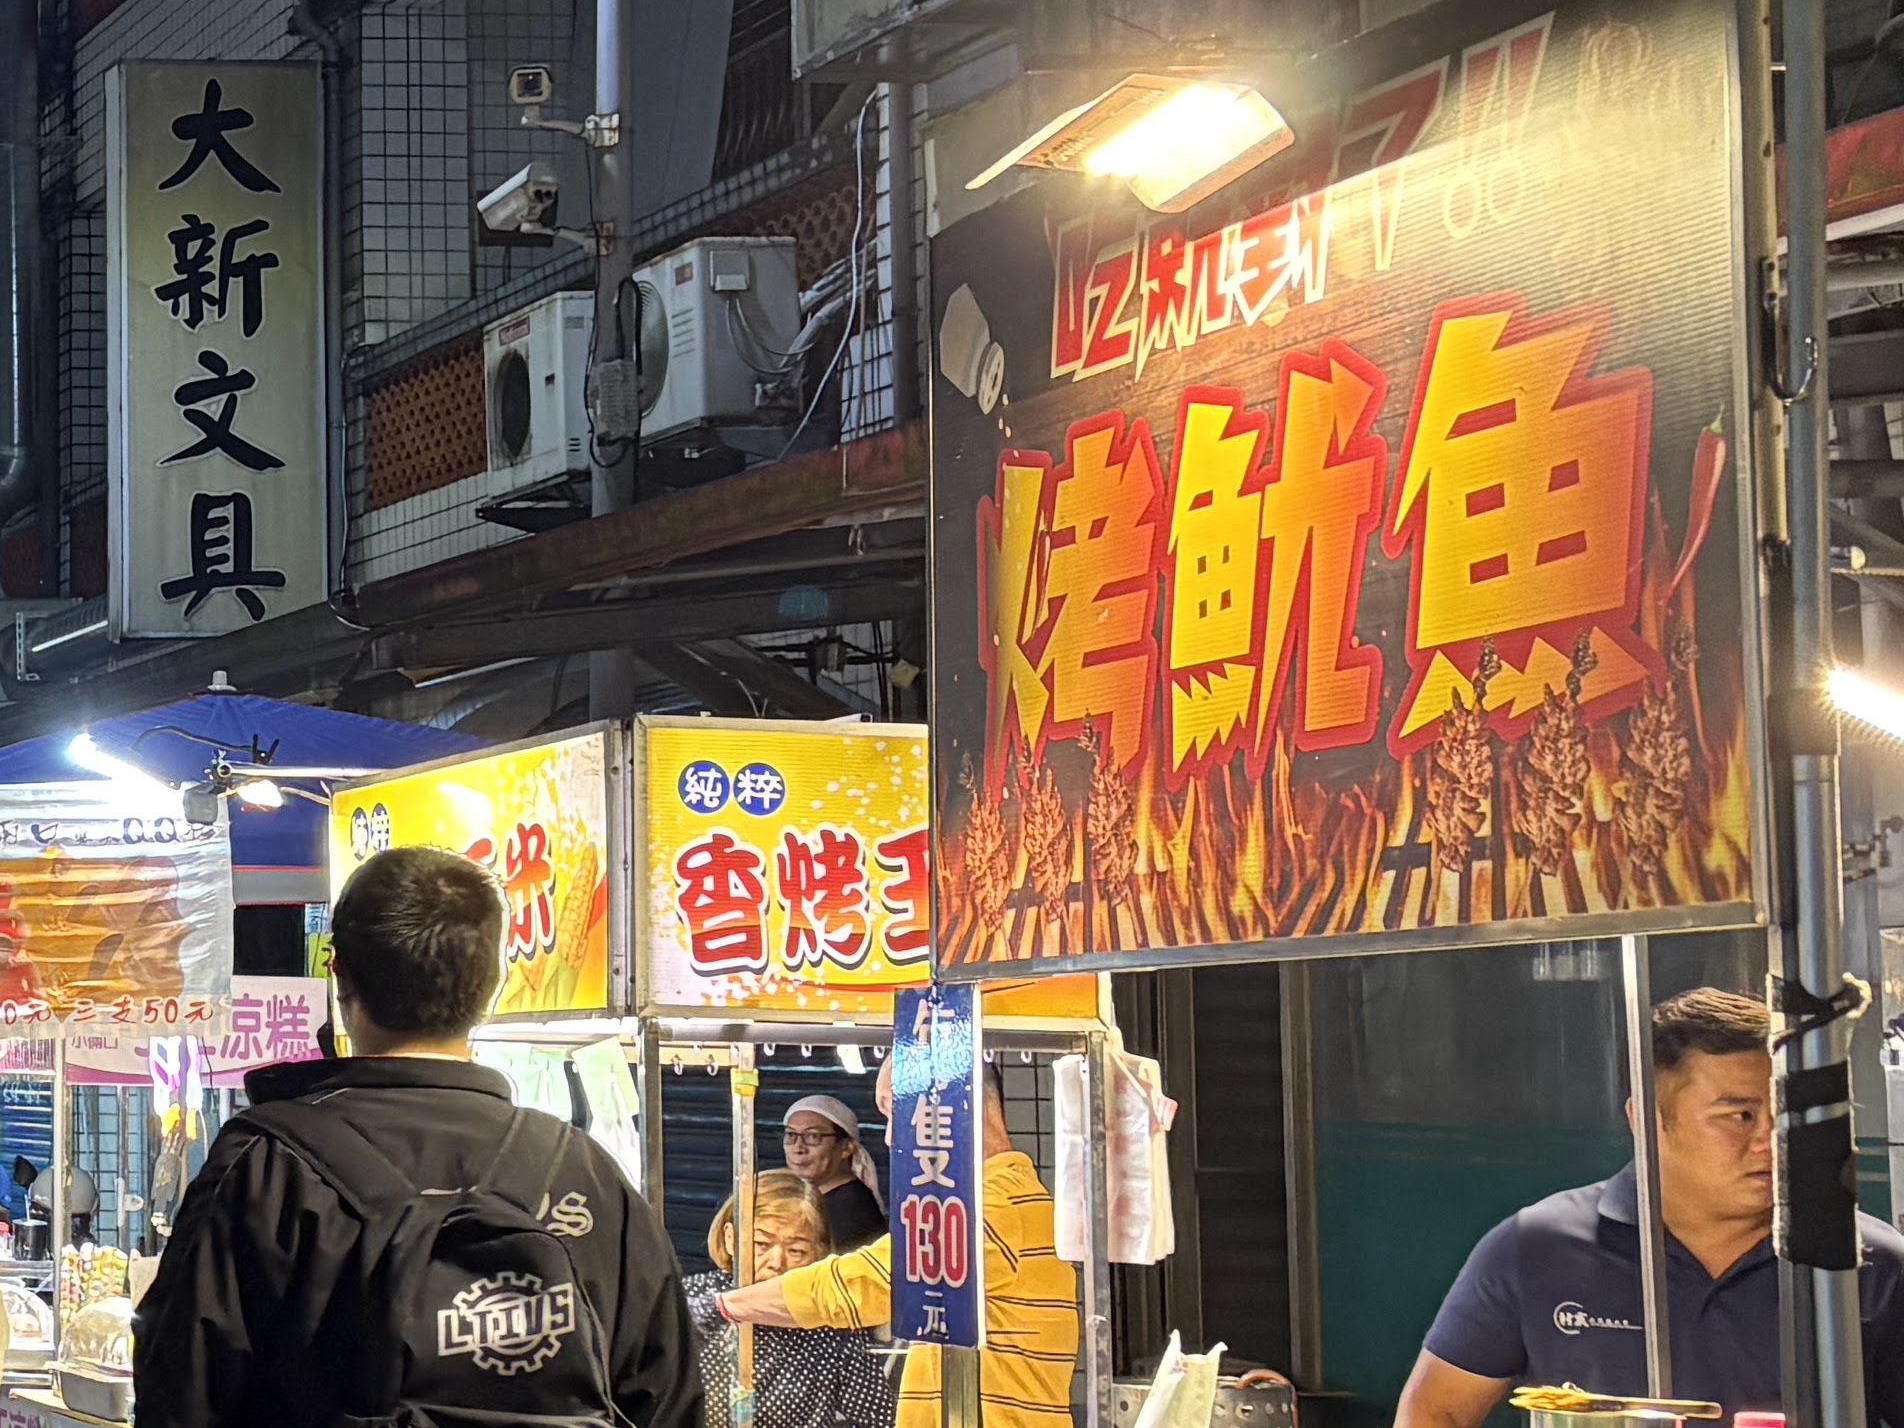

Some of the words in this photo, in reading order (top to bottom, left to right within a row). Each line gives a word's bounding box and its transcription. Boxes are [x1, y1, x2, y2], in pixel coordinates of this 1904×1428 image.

[154, 78, 286, 622] 大新文具
[980, 290, 1655, 798] 烤魷魚
[683, 766, 783, 813] 純粹
[74, 997, 214, 1027] 三支50元
